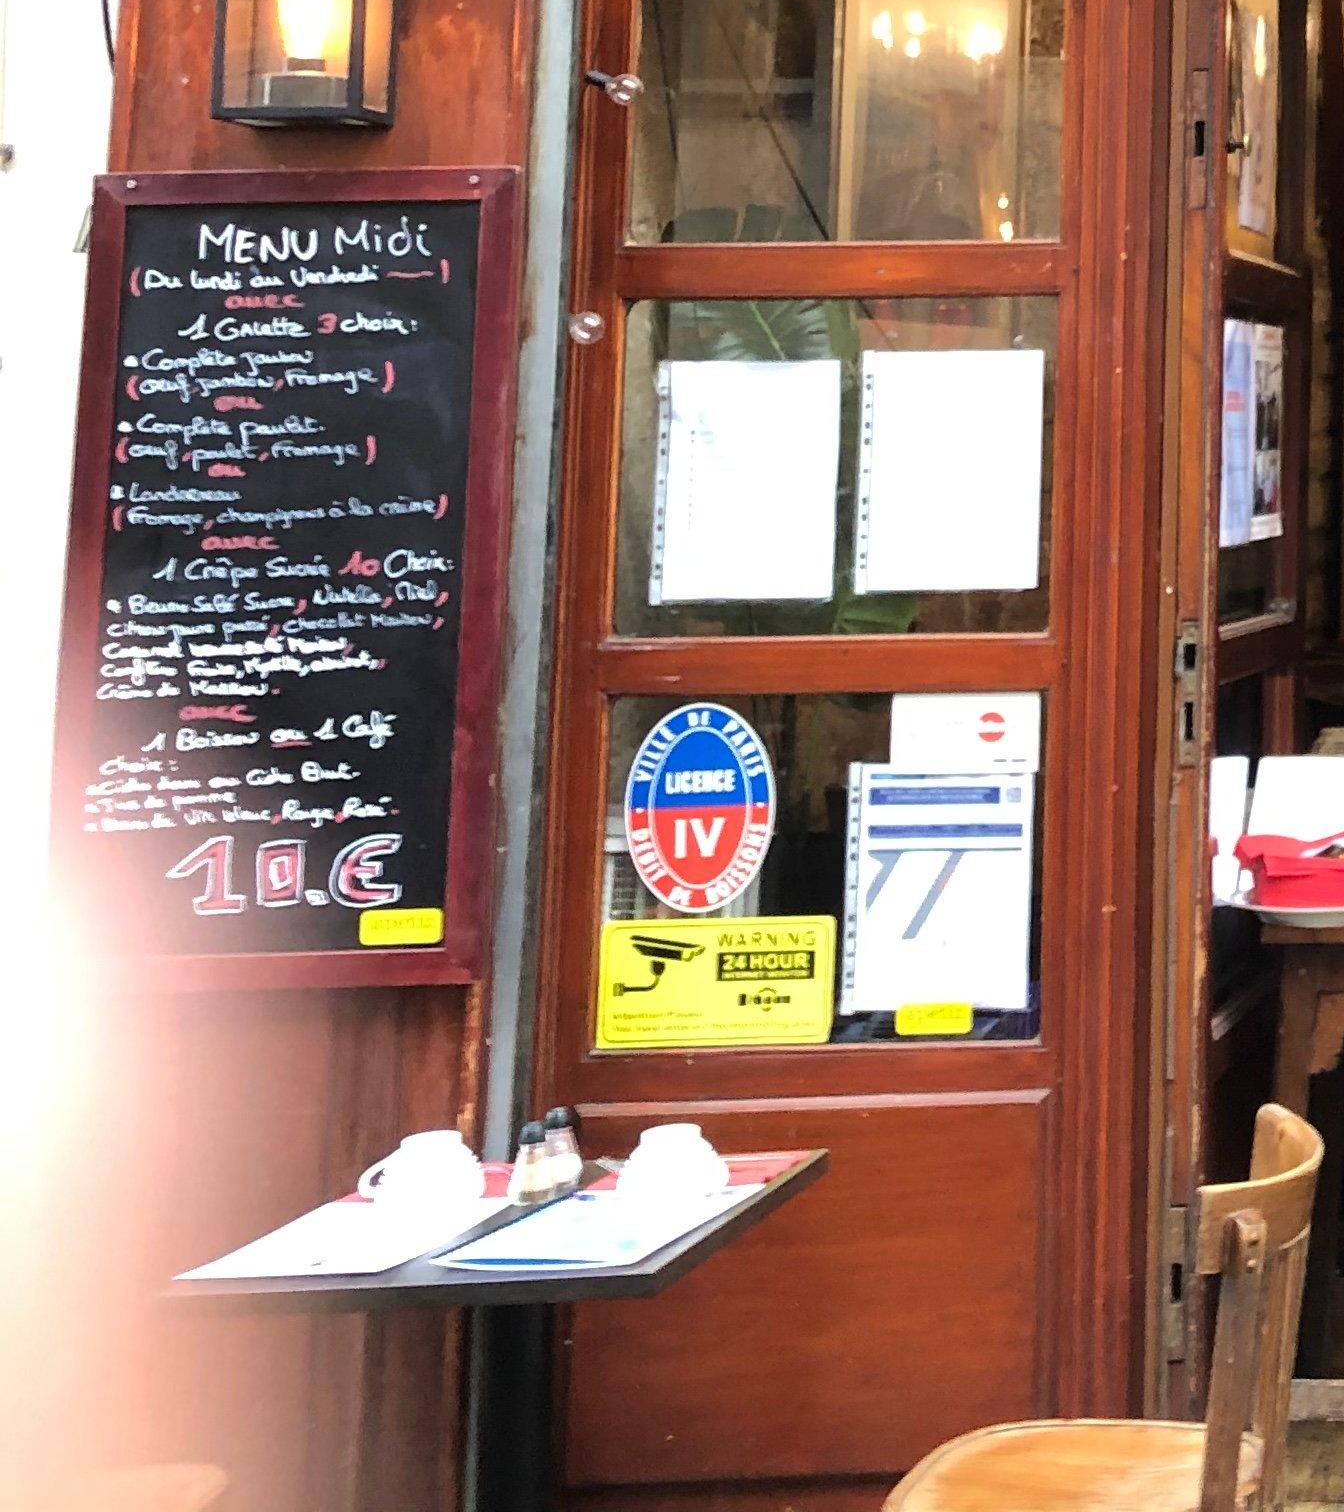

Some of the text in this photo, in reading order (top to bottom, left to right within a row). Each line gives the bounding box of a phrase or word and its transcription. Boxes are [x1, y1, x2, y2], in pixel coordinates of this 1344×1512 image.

[198, 216, 432, 263] MENU Midi
[190, 269, 242, 290] lundi
[249, 272, 285, 288] au
[177, 313, 211, 340] 1
[317, 313, 338, 335] 3
[152, 556, 179, 581] 1
[141, 732, 166, 752] 1
[314, 717, 339, 740] 1
[341, 710, 398, 749] Café
[722, 716, 766, 779] PARIS
[664, 769, 737, 796] LICENCE
[673, 817, 727, 859] IV
[722, 953, 810, 969] 24 HOUR
